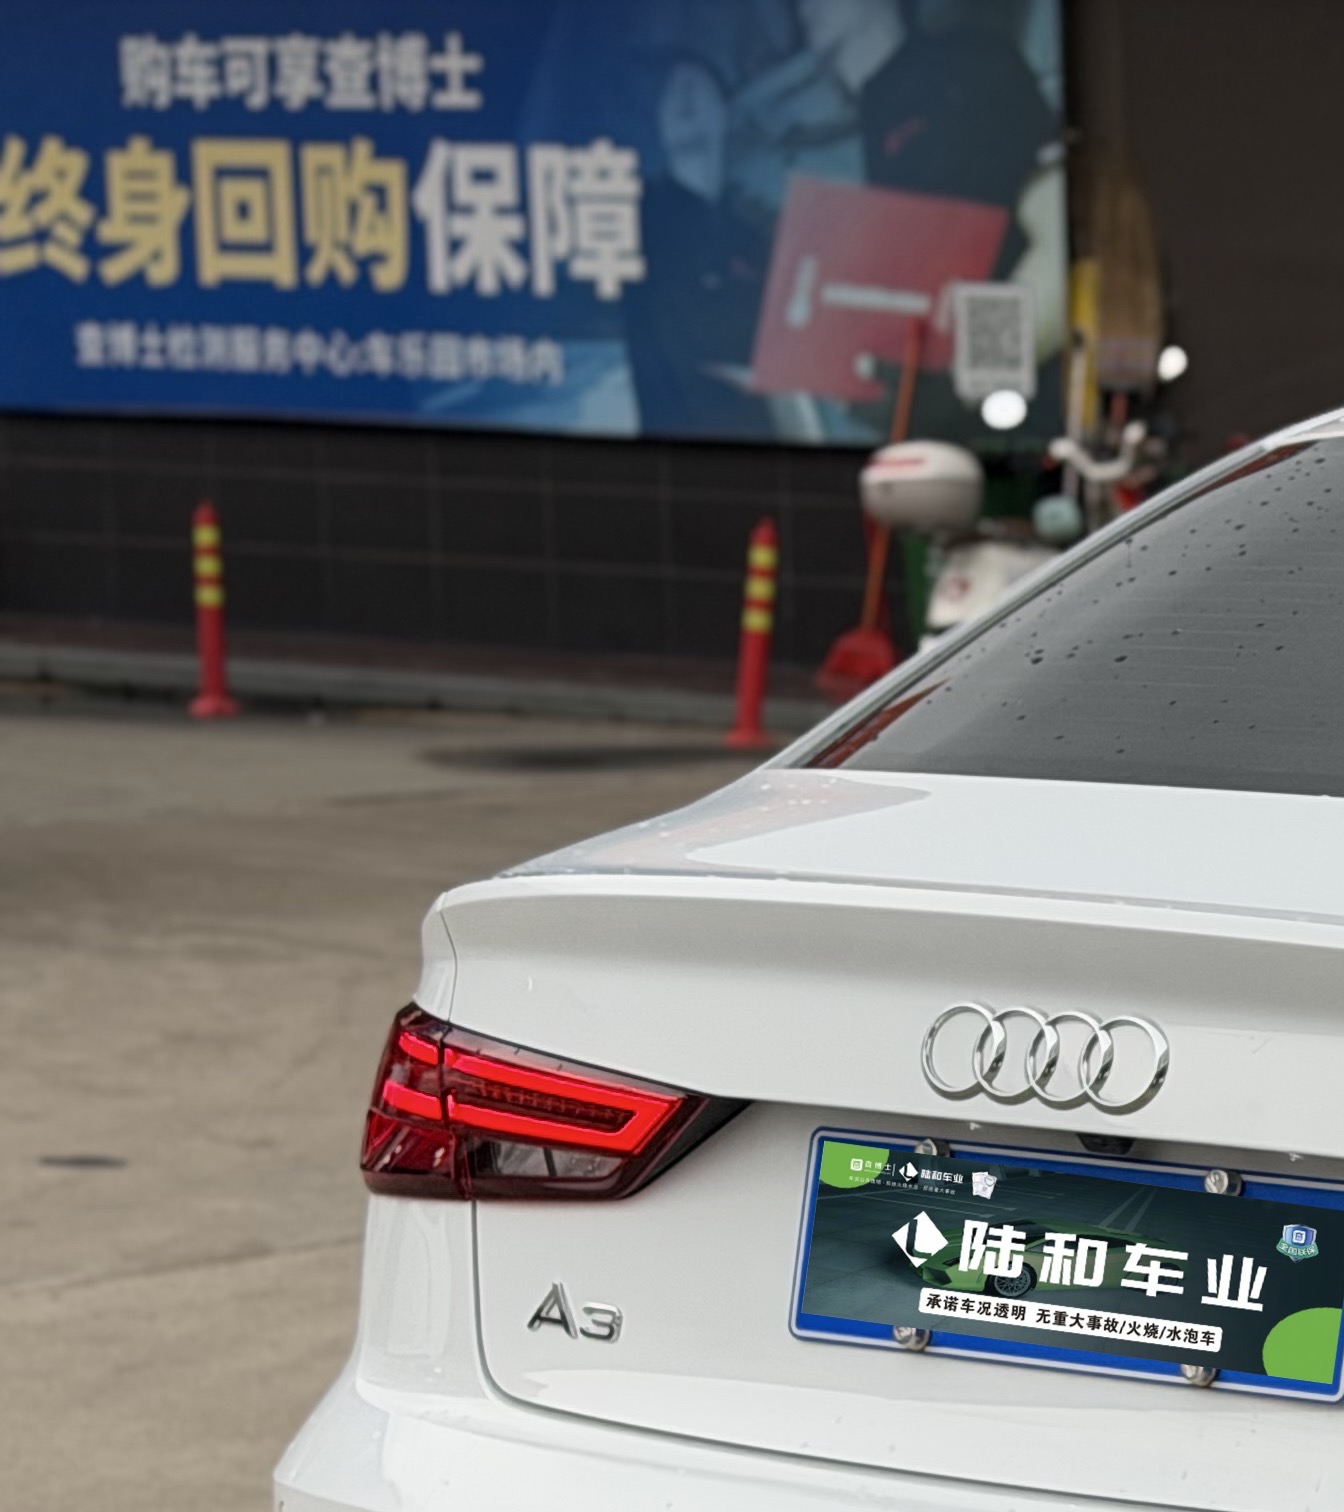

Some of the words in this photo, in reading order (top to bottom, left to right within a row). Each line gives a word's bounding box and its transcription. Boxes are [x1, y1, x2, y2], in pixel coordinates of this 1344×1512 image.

[118, 33, 484, 112] 购车可享查博士
[0, 137, 648, 300] 终身回购保障
[527, 1281, 623, 1344] A3
